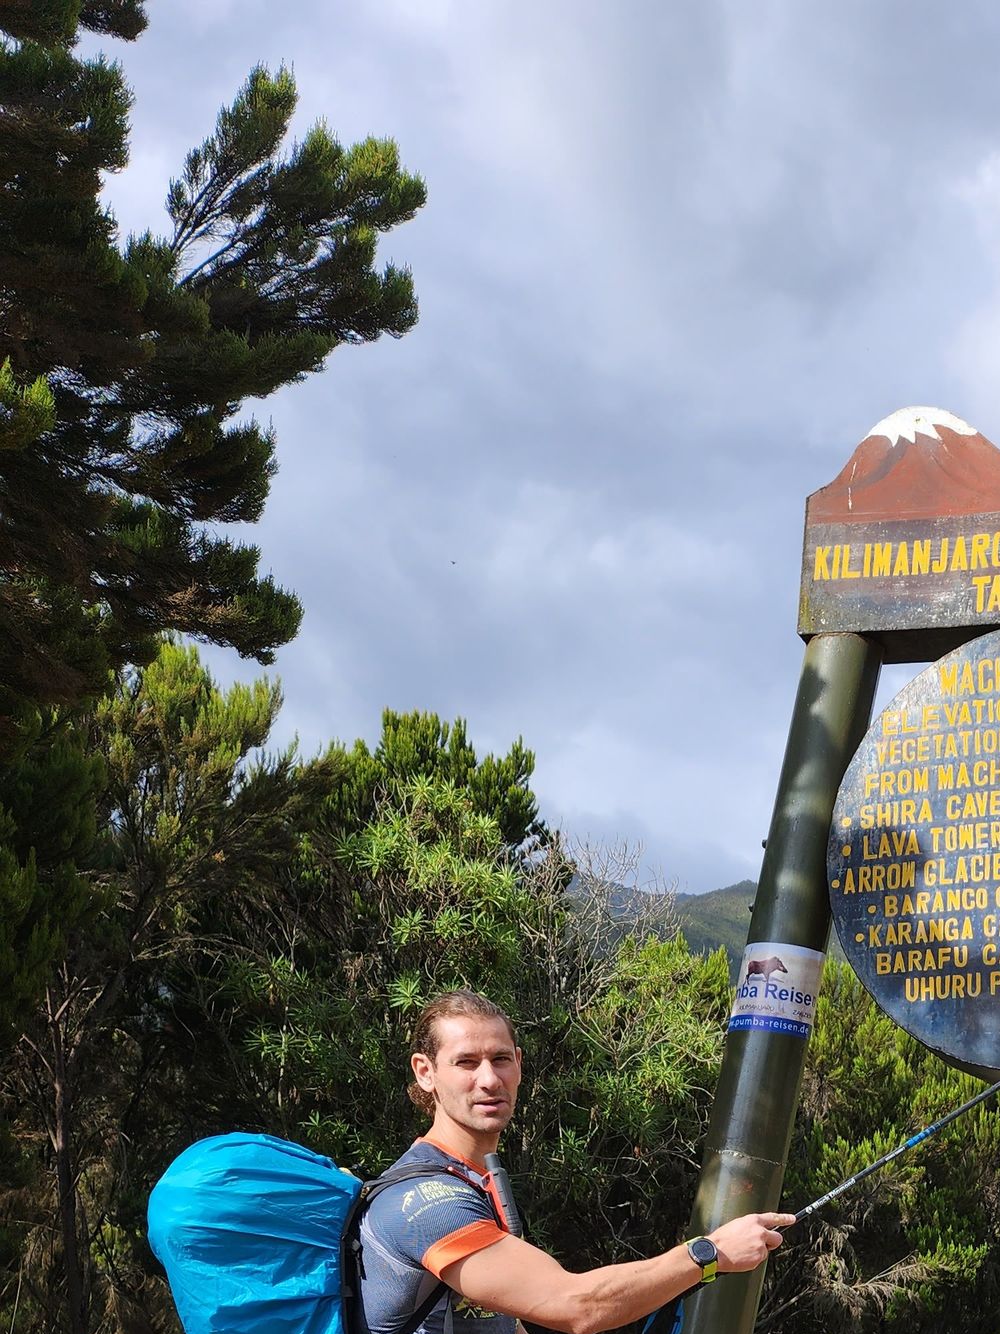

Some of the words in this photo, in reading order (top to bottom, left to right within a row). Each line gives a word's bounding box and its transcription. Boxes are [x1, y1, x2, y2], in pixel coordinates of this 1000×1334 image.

[864, 767, 929, 798] FROM
[860, 799, 933, 829] SHIRA
[863, 830, 919, 860] LAVA
[844, 861, 915, 894] ARROW
[884, 889, 988, 918] BARANCO
[868, 917, 973, 948] KARANGA
[876, 945, 968, 975] BARAFU
[905, 972, 981, 1003] UHURU
